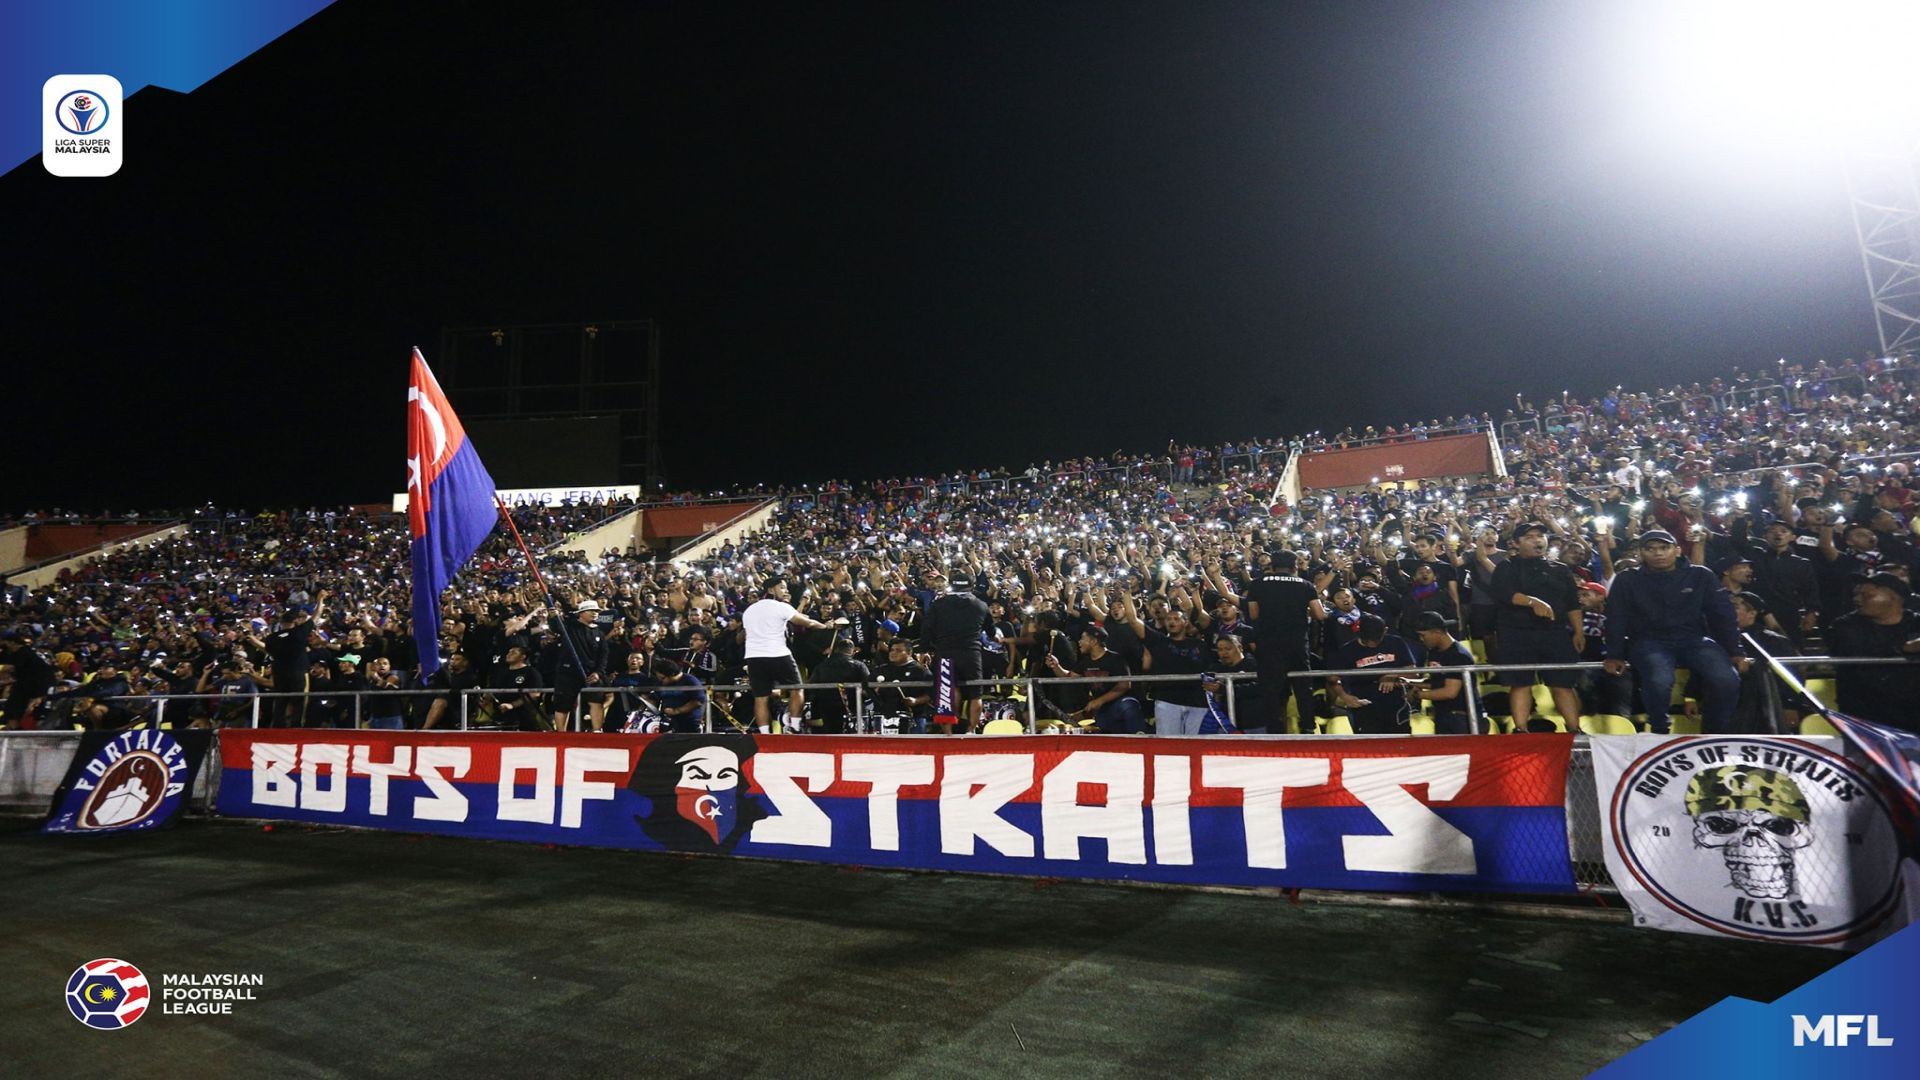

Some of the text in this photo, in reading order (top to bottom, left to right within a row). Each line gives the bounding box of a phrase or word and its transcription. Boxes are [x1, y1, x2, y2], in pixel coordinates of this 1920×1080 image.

[501, 492, 553, 505] HANG
[74, 729, 188, 798] FORTALEZA
[1635, 745, 1864, 802] BOYS OF STRAITS
[251, 742, 1477, 875] BOYS OF STRAITS
[1733, 896, 1818, 928] K.V.C
